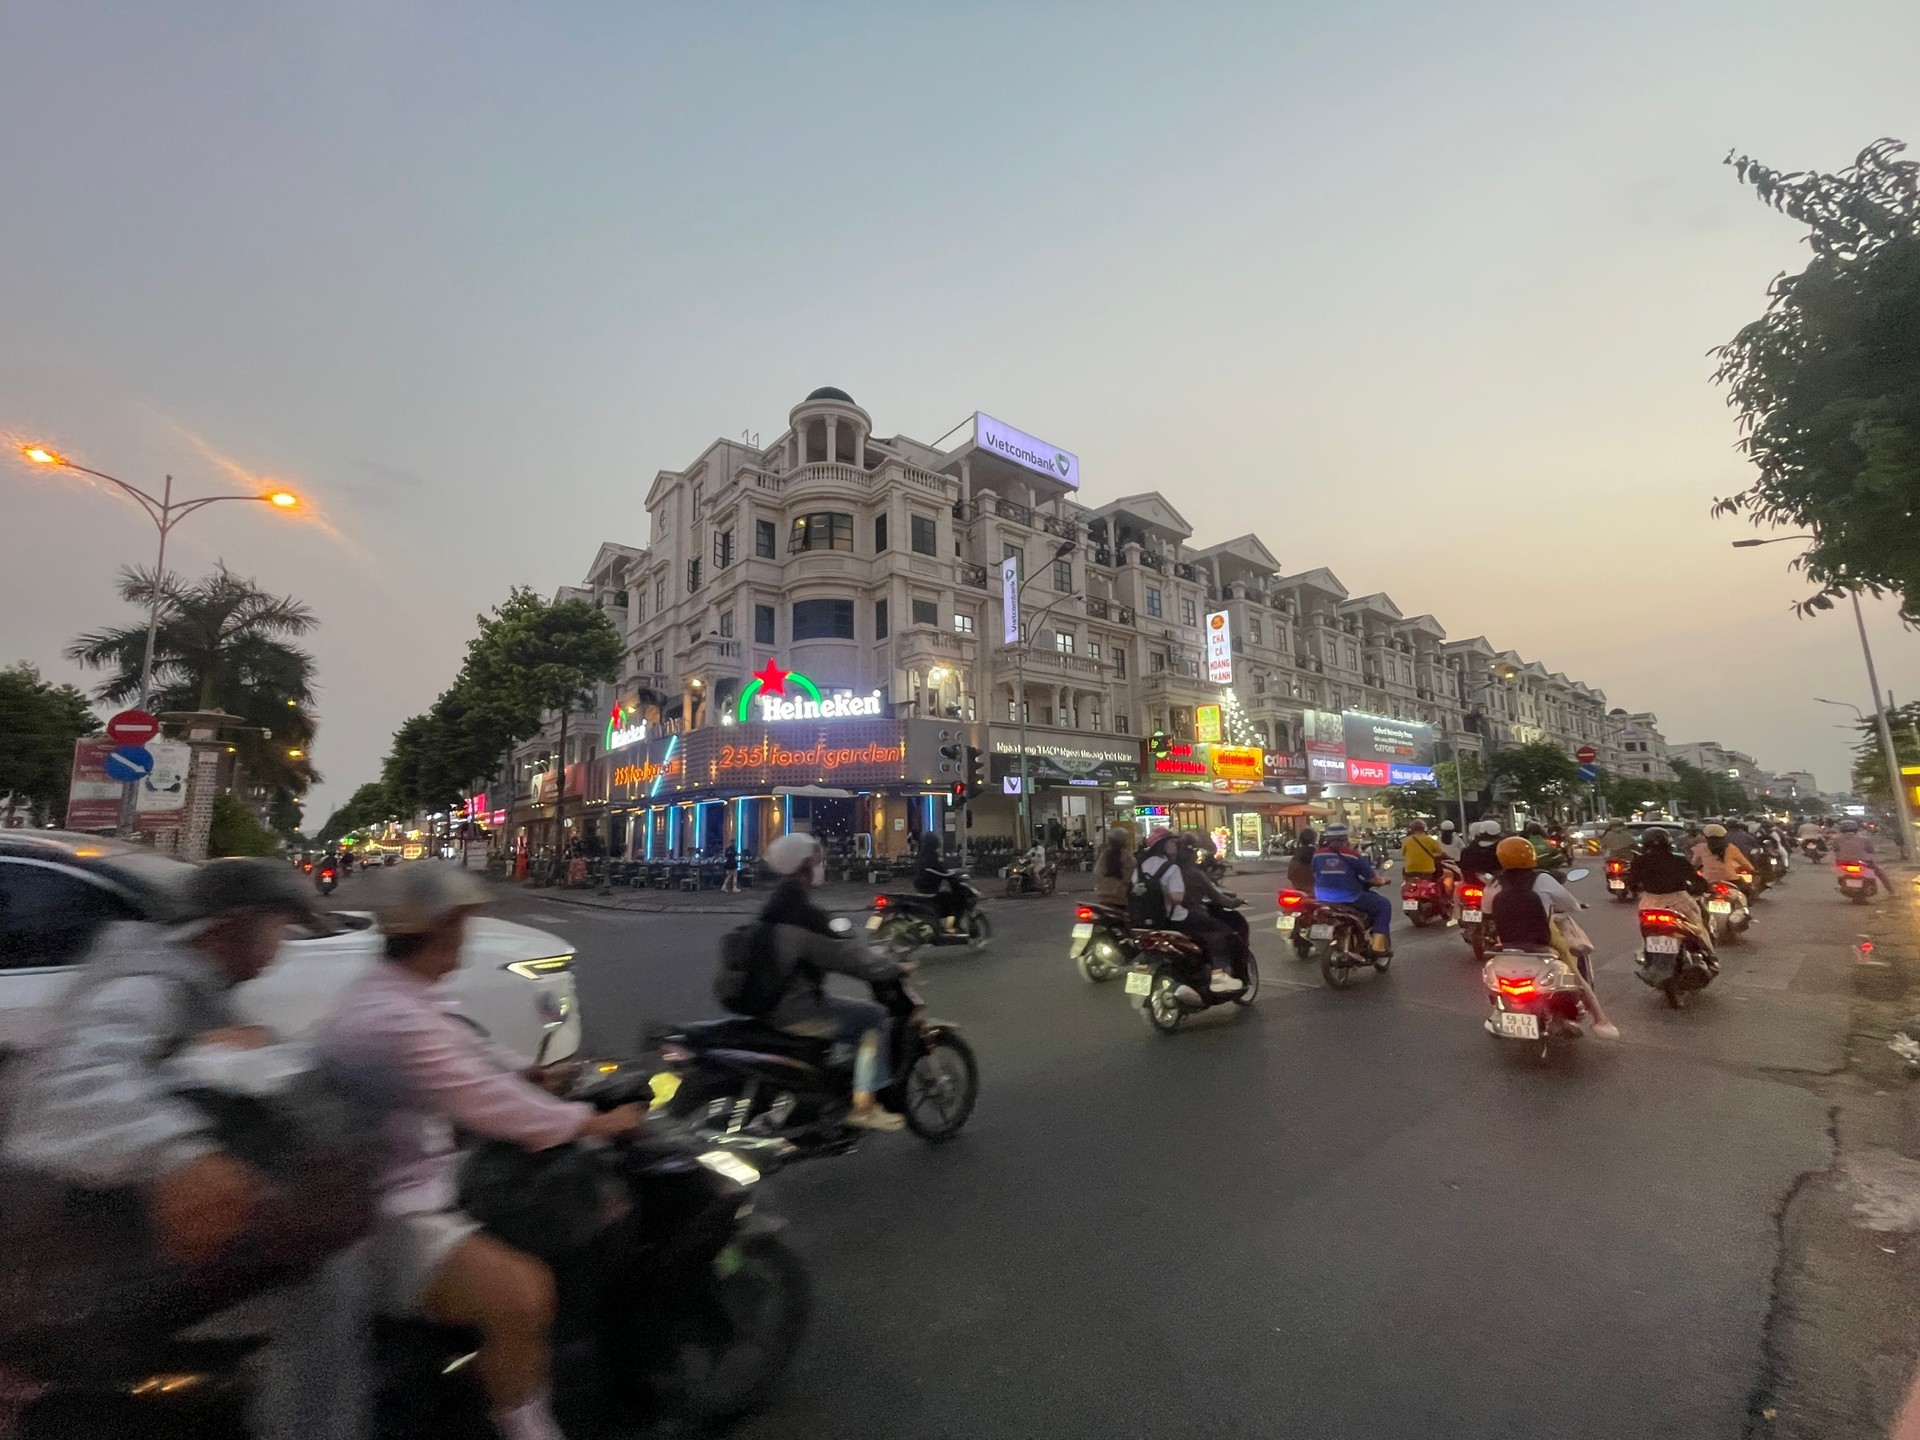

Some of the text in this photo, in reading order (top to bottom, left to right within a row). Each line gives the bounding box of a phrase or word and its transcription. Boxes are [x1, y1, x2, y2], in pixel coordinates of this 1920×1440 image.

[985, 431, 1056, 472] Vietcombank
[1010, 579, 1018, 633] Vietcombank
[762, 691, 881, 722] Heineken
[611, 721, 647, 750] Heineken
[719, 742, 900, 769] 255 food garden
[614, 766, 628, 786] 255
[1359, 768, 1384, 779] KAPLA
